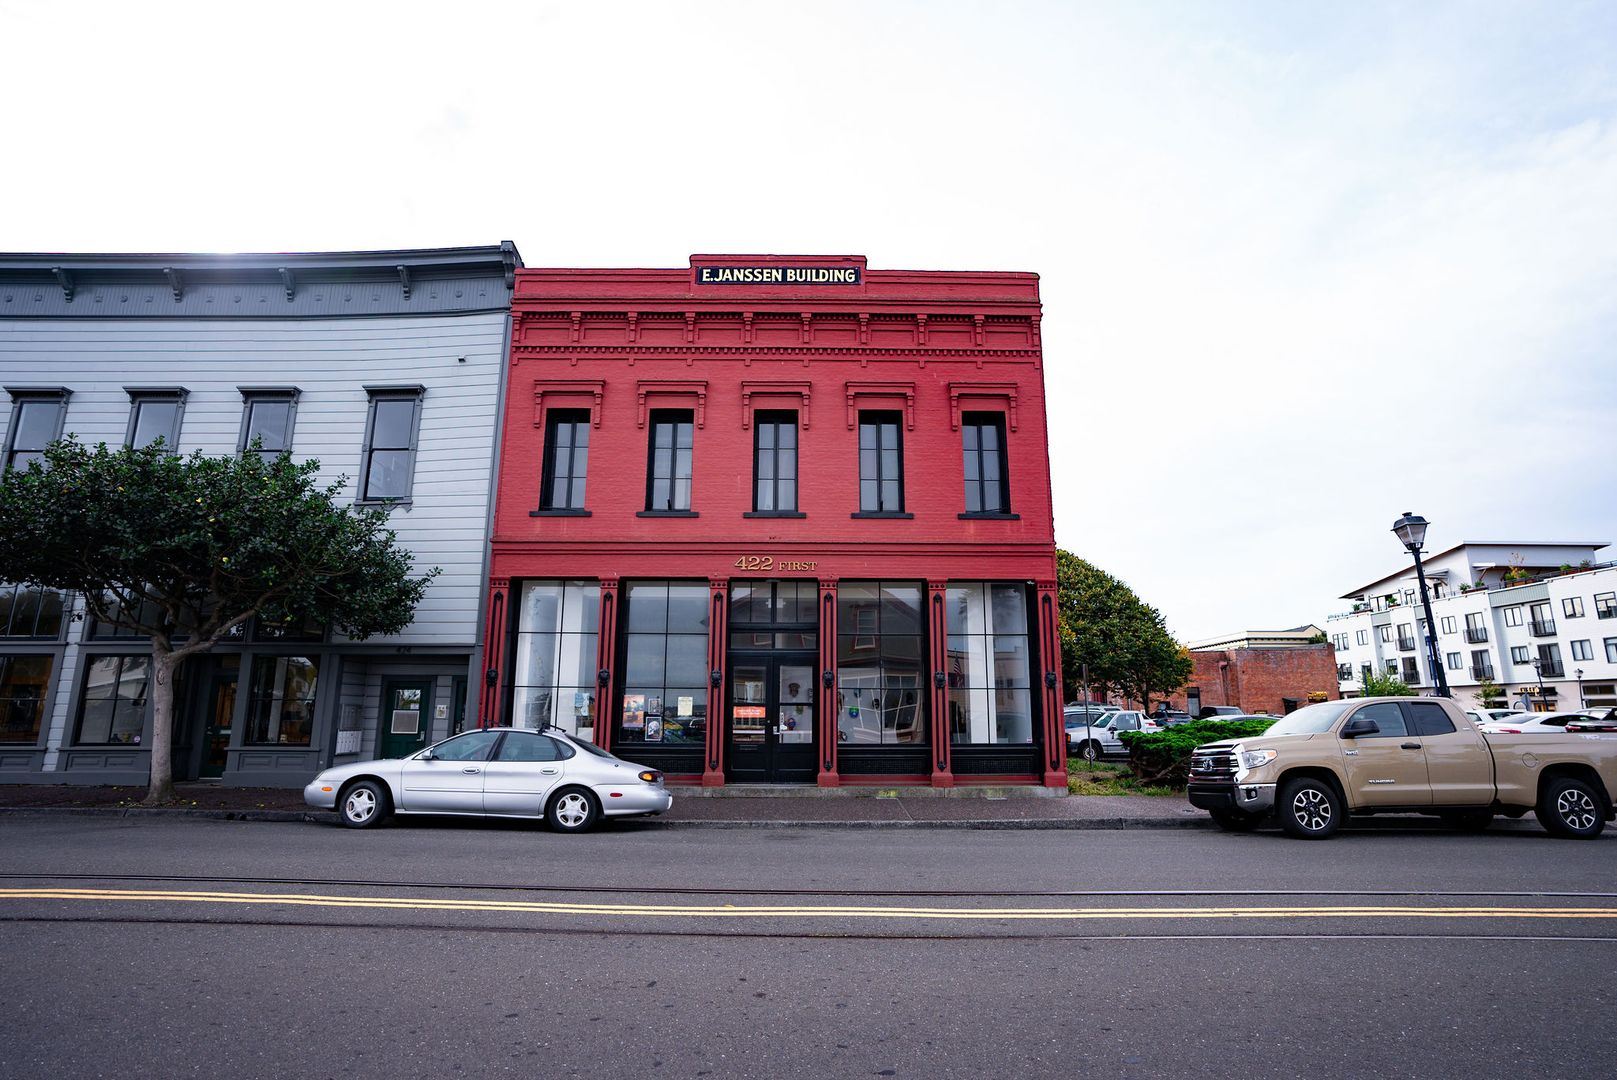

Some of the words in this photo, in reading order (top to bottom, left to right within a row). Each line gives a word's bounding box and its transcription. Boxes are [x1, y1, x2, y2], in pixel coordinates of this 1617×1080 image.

[786, 269, 856, 283] BUILDING
[734, 556, 773, 571] 422
[778, 561, 818, 571] FIRST
